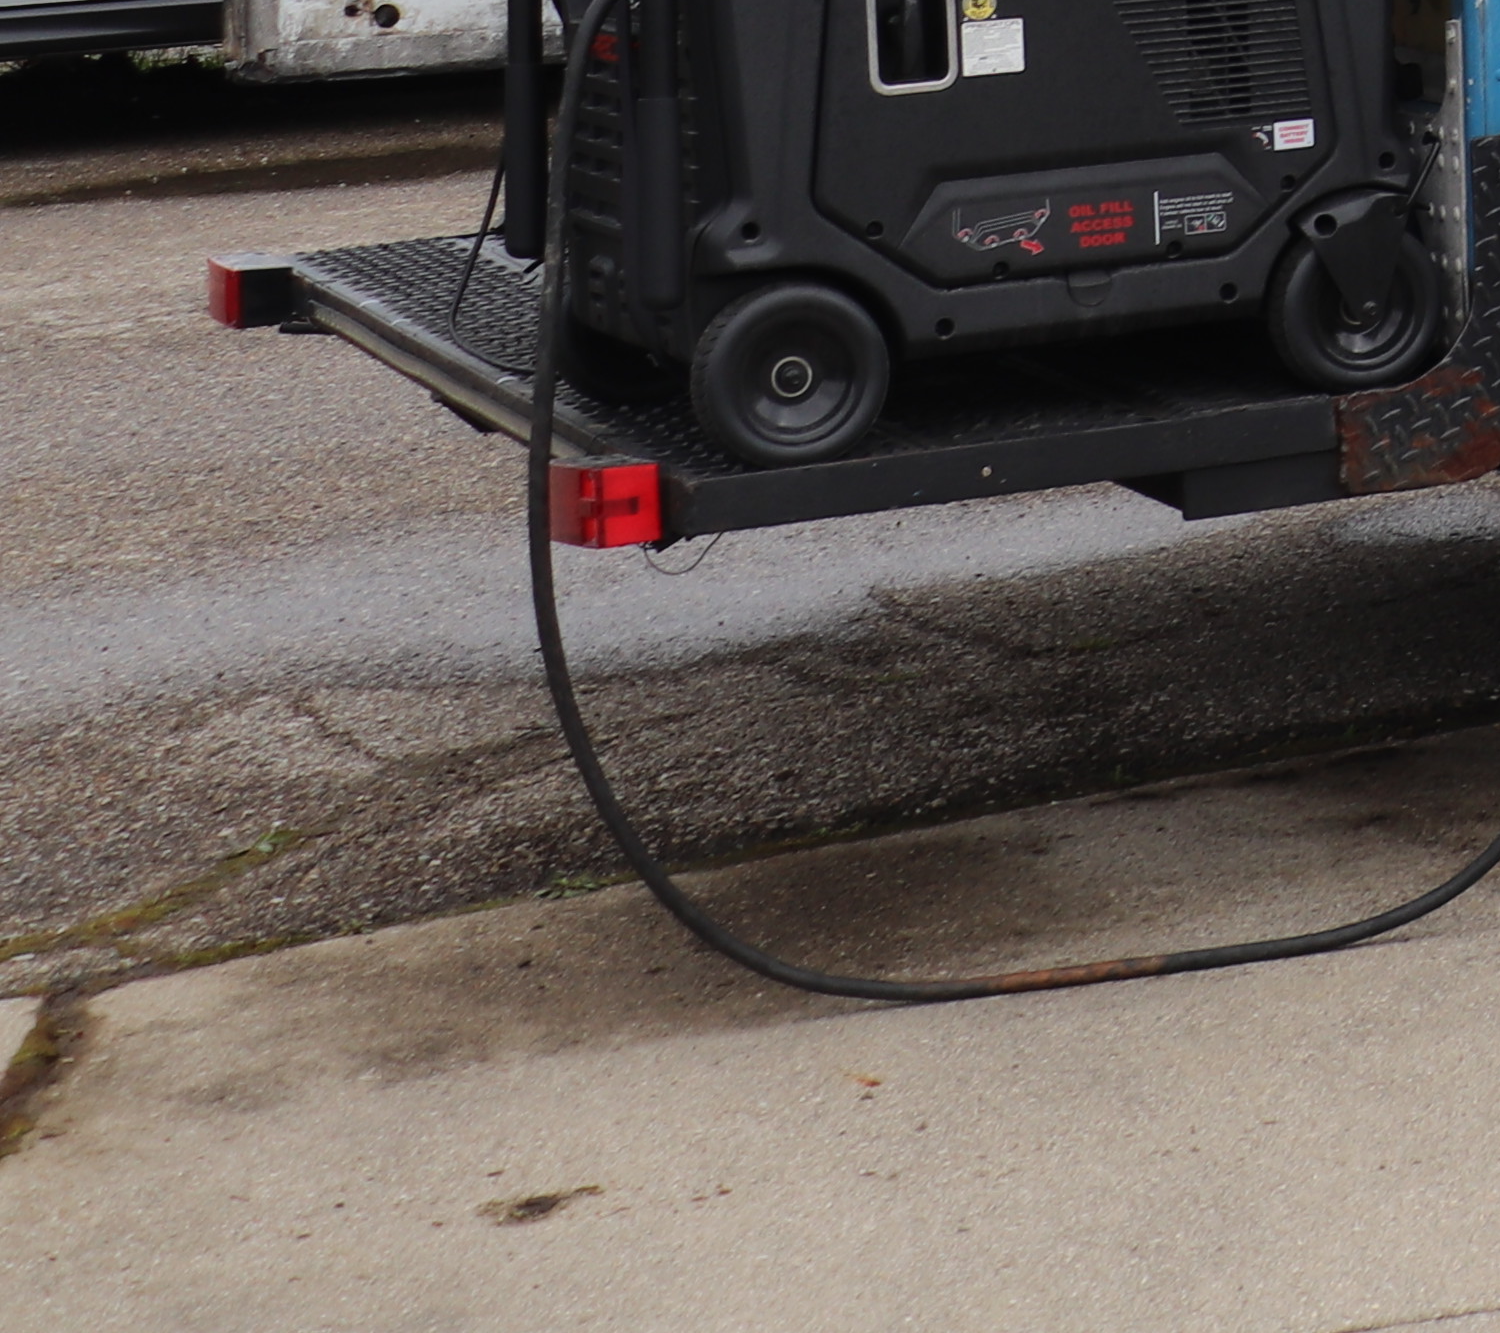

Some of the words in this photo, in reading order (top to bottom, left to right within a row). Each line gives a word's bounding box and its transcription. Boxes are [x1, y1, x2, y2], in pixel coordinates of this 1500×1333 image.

[1069, 204, 1095, 219] OIL
[1100, 201, 1134, 214] FILL
[1070, 215, 1134, 233] ACCESS
[1079, 232, 1126, 249] DOOR
